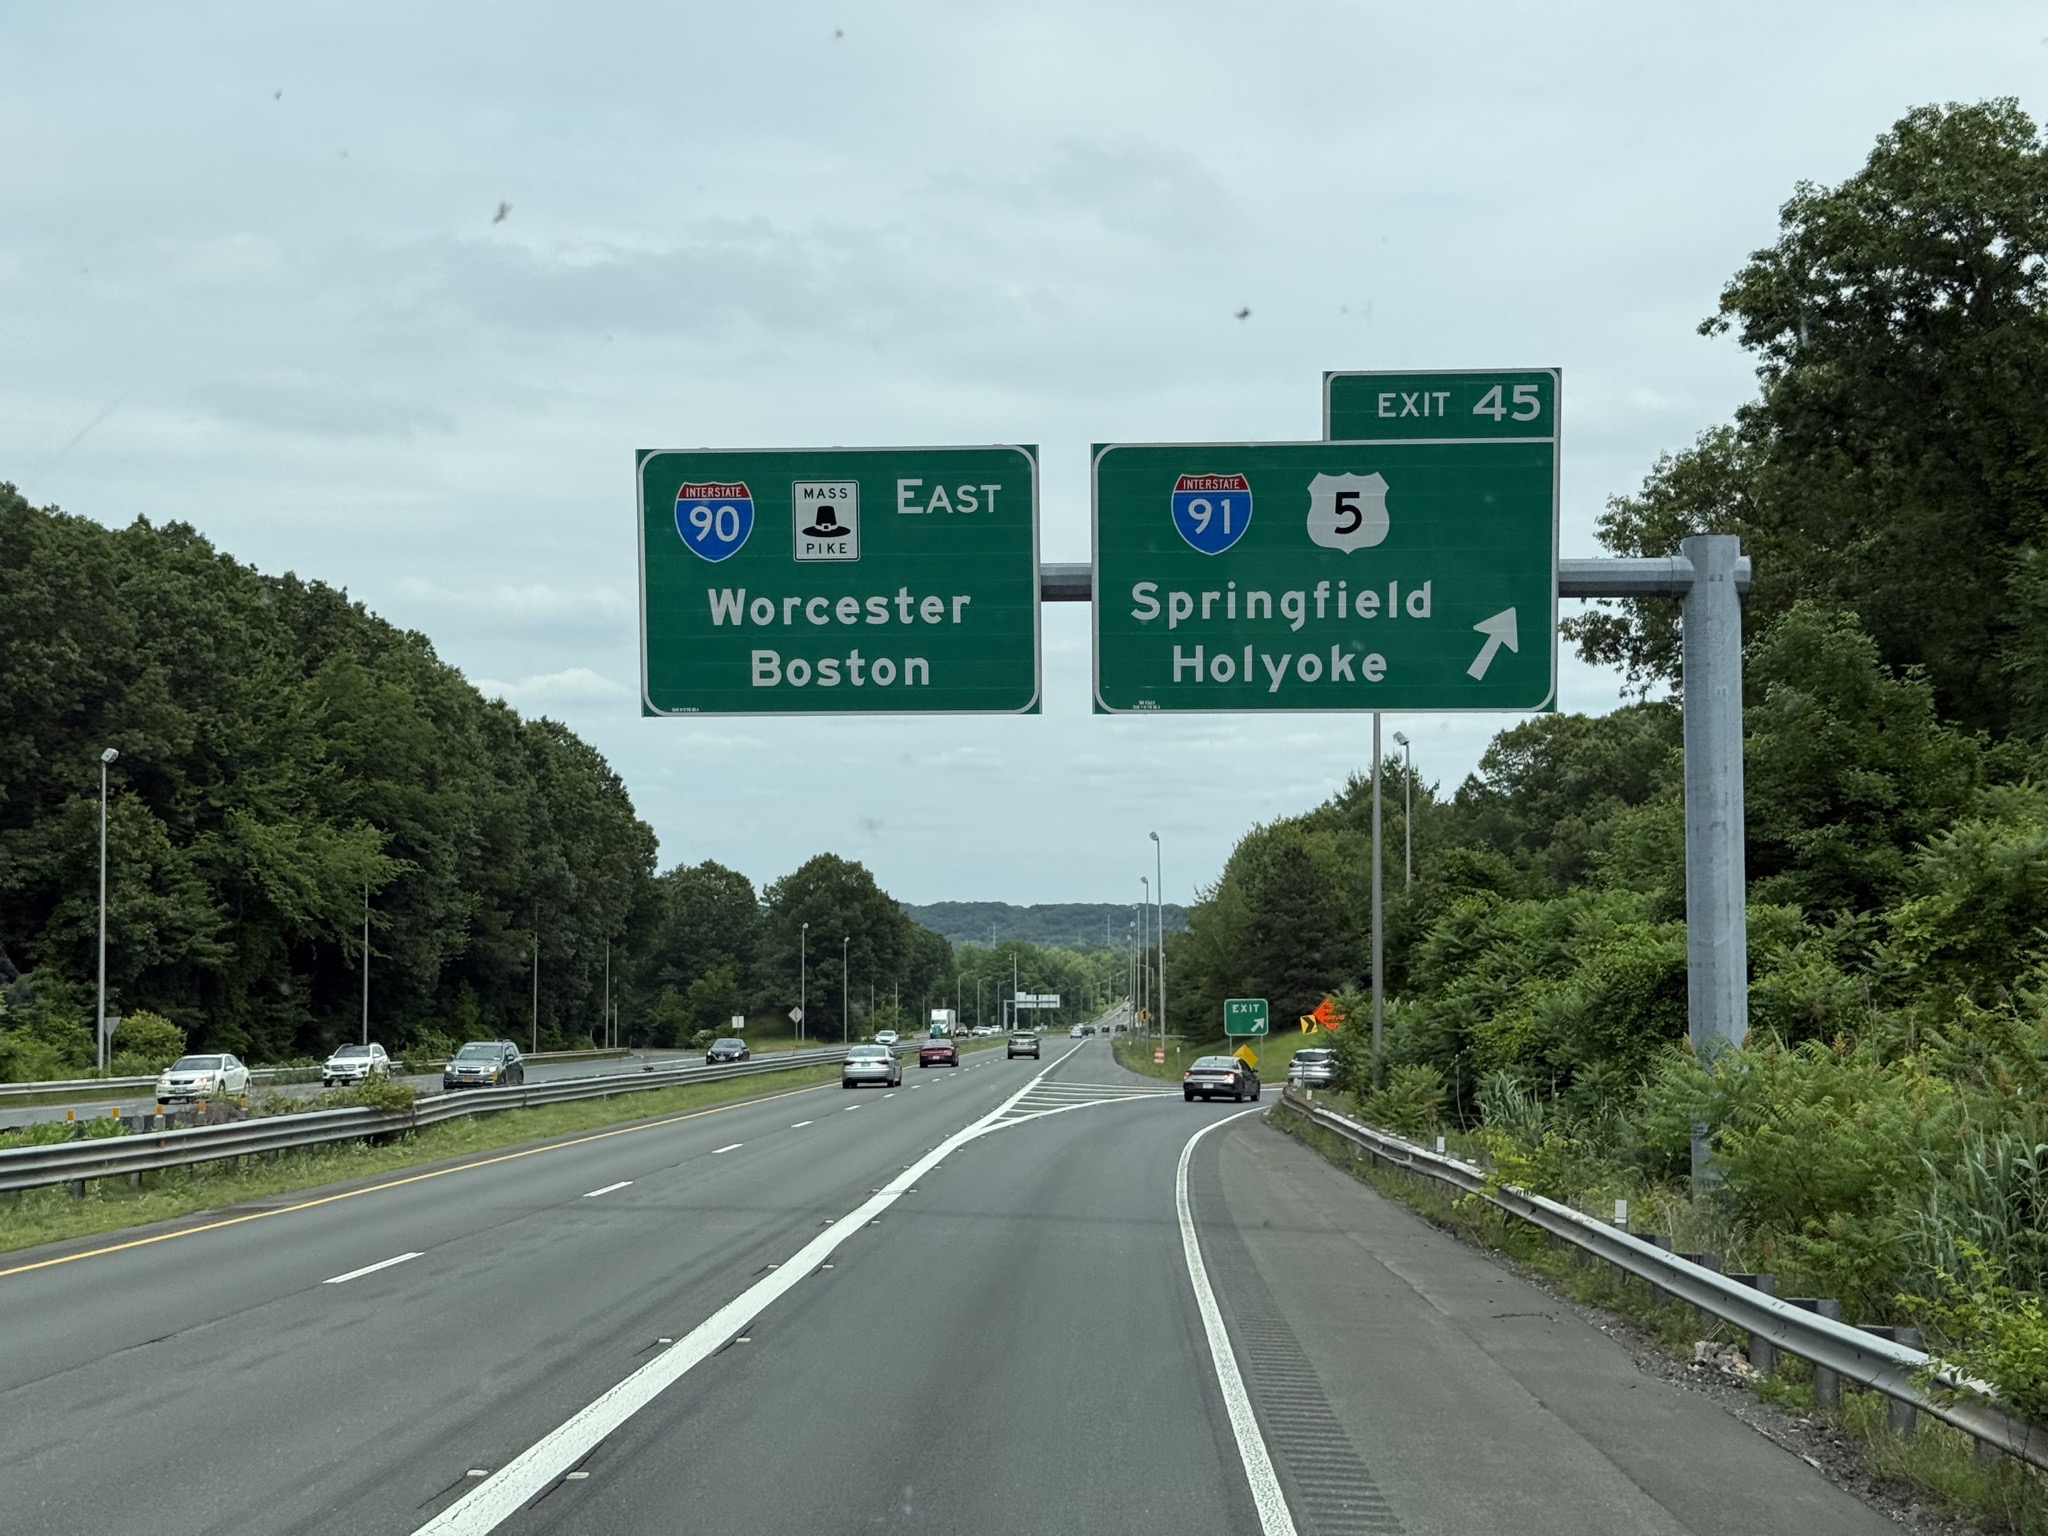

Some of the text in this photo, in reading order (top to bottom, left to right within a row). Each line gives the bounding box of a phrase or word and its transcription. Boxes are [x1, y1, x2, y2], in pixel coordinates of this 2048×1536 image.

[1378, 385, 1541, 422] EXIT 45
[686, 487, 743, 499] INTERSTATE
[804, 488, 848, 500] MASS
[897, 479, 1002, 514] EAST
[1183, 478, 1240, 490] INTERSTATE
[689, 506, 740, 542] 90
[1188, 499, 1231, 535] 91
[1334, 491, 1363, 535] 5
[806, 543, 848, 555] PIKE
[708, 587, 972, 626] Worcester
[1131, 580, 1432, 632] Springfield
[752, 649, 930, 687] Boston
[1173, 644, 1388, 693] Holyoke
[1232, 1004, 1260, 1013] EXIT
